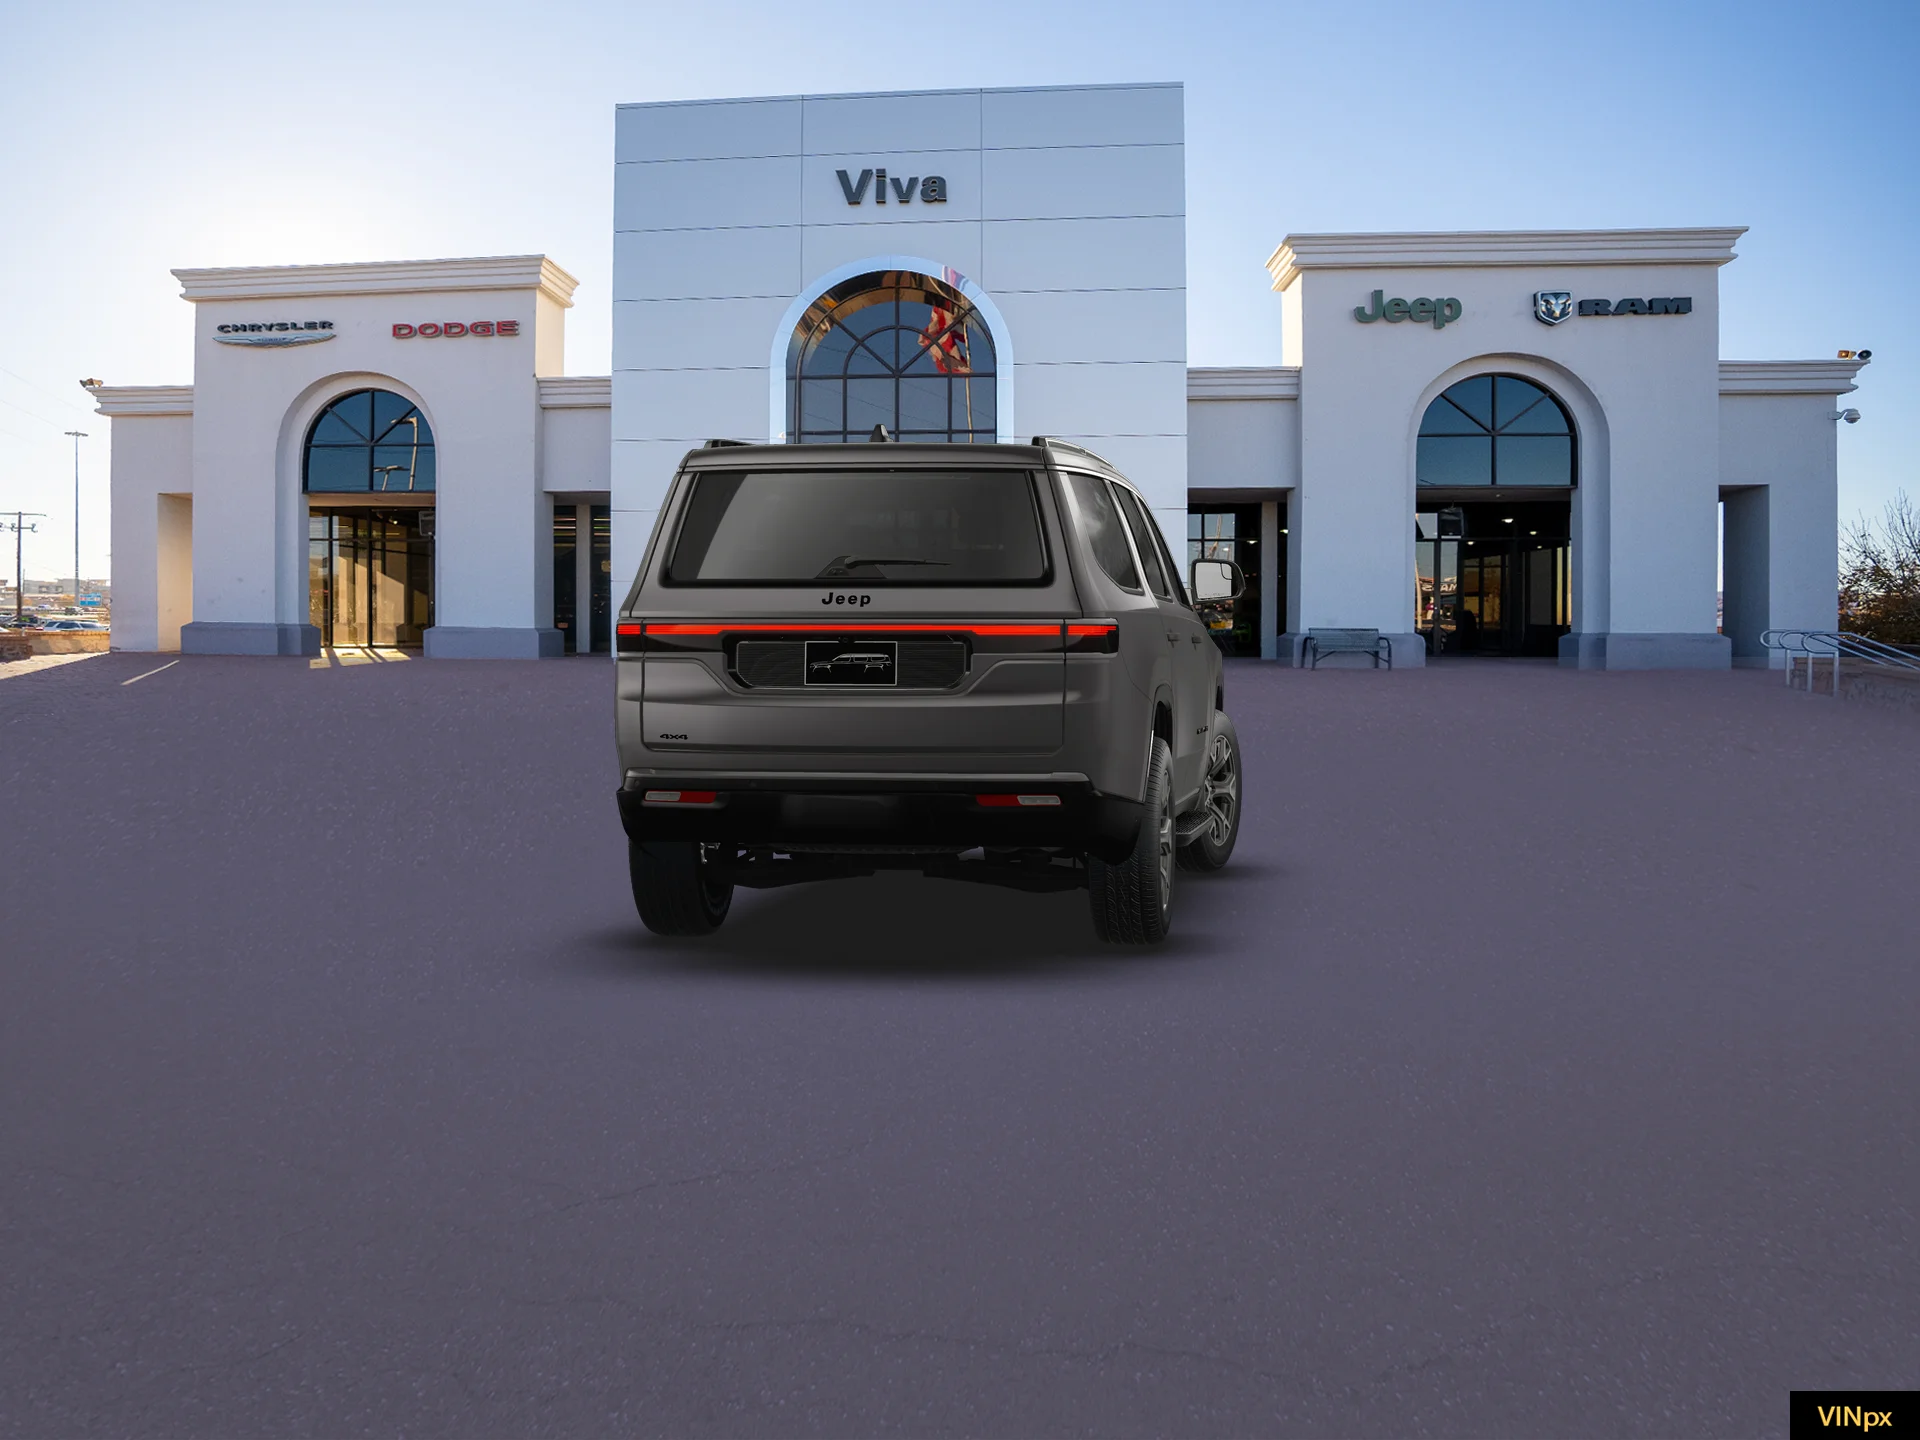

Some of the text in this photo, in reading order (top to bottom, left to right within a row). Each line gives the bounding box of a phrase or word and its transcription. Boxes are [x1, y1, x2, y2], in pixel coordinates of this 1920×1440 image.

[835, 168, 947, 205] Viva
[1353, 289, 1462, 330] Jeep
[1578, 297, 1692, 316] RAM
[217, 320, 334, 333] CHRYSLER
[392, 319, 520, 339] DODGE
[821, 592, 871, 607] Jeep
